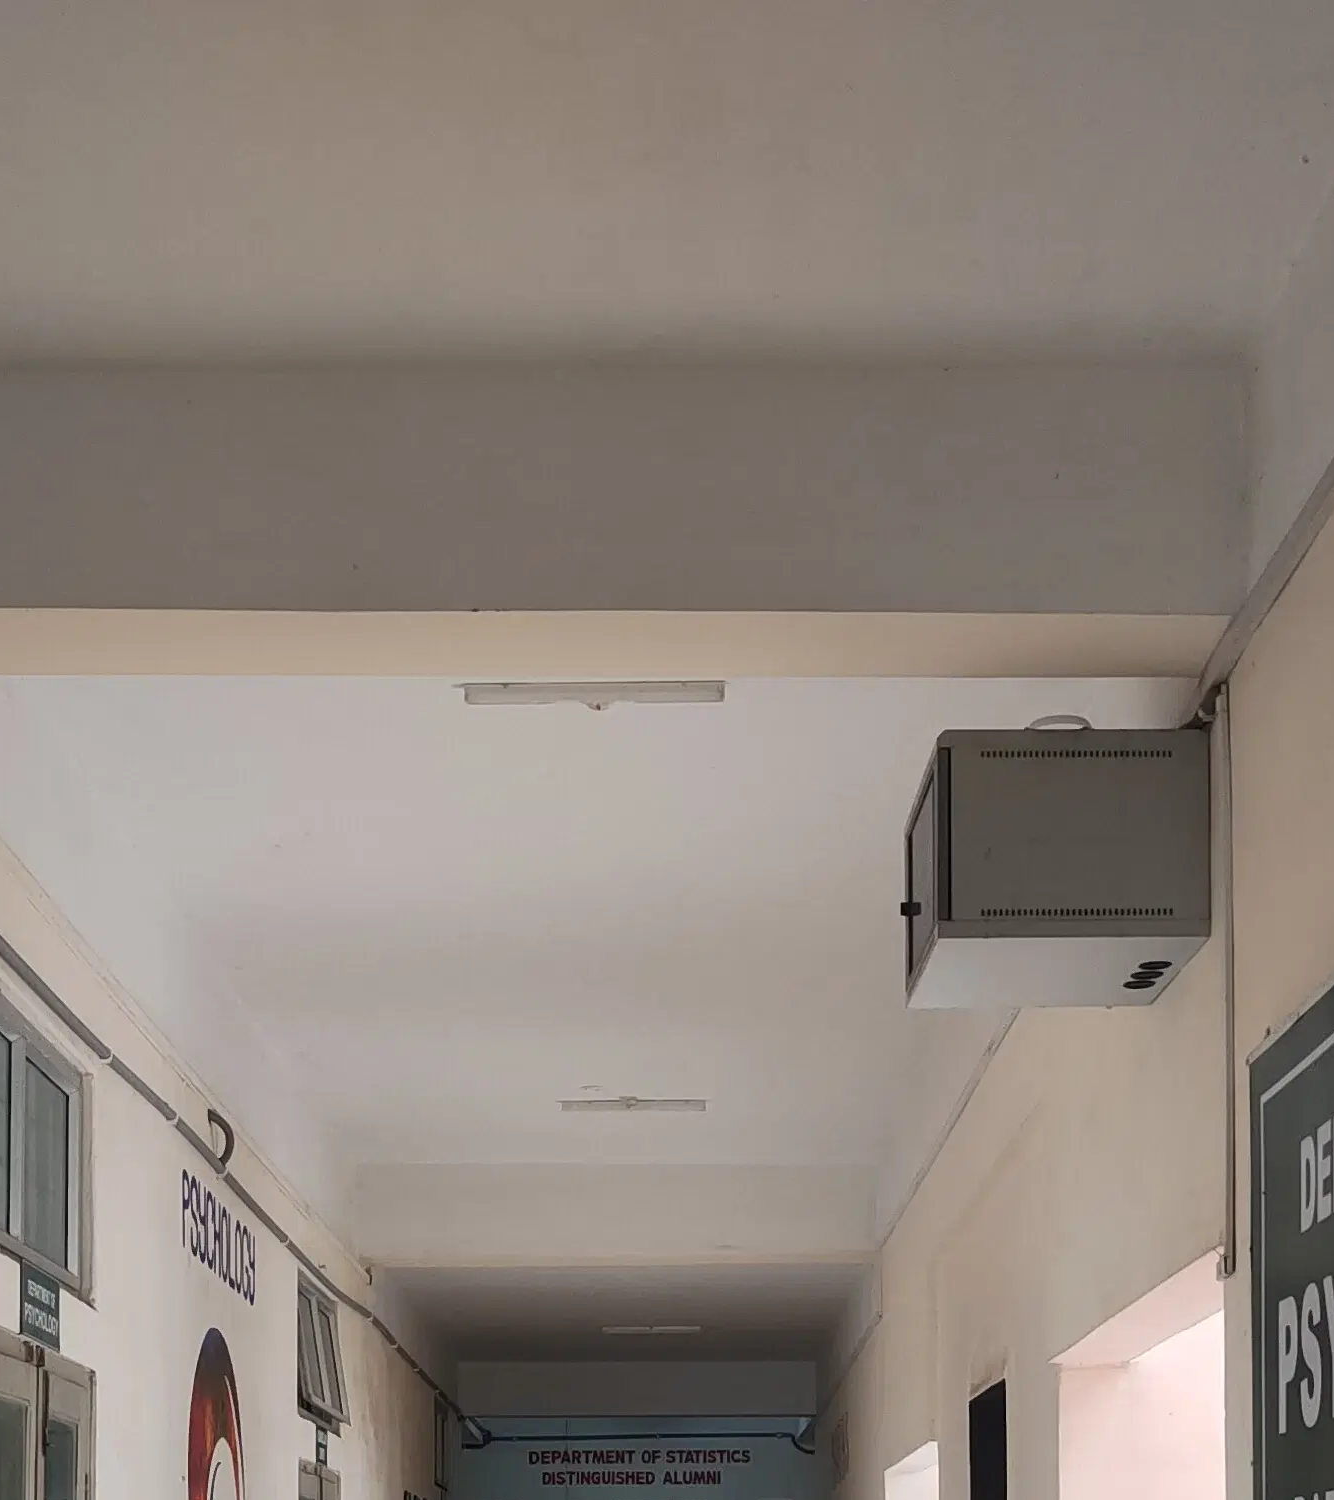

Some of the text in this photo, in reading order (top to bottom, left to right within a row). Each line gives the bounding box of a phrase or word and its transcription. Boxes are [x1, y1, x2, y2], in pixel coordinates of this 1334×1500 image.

[181, 1168, 257, 1307] PSYCHOLOGY
[24, 1301, 59, 1337] PSYCHOLOGY
[528, 1449, 751, 1465] DEPARTMENT OF STATISTICS
[542, 1470, 722, 1486] DISTINGUISHED ALUMNI
